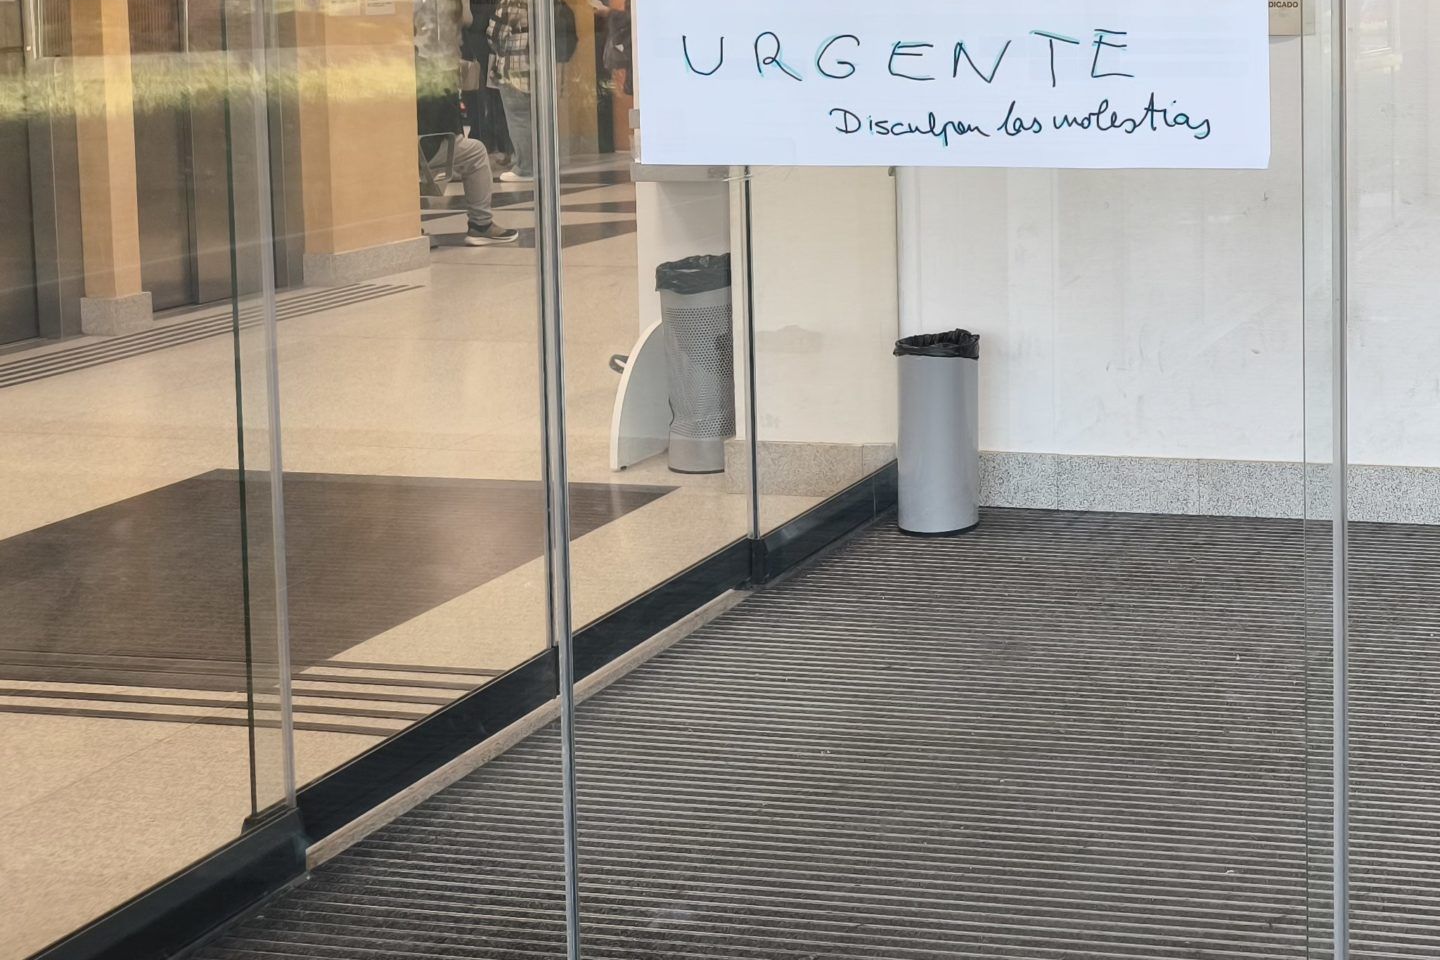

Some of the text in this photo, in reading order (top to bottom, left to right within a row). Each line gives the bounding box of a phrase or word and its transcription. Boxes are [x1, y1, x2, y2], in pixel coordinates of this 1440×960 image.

[1268, 1, 1299, 9] DICADO
[682, 28, 1135, 87] URGENTE
[997, 100, 1042, 136] las
[1052, 91, 1212, 139] molestias
